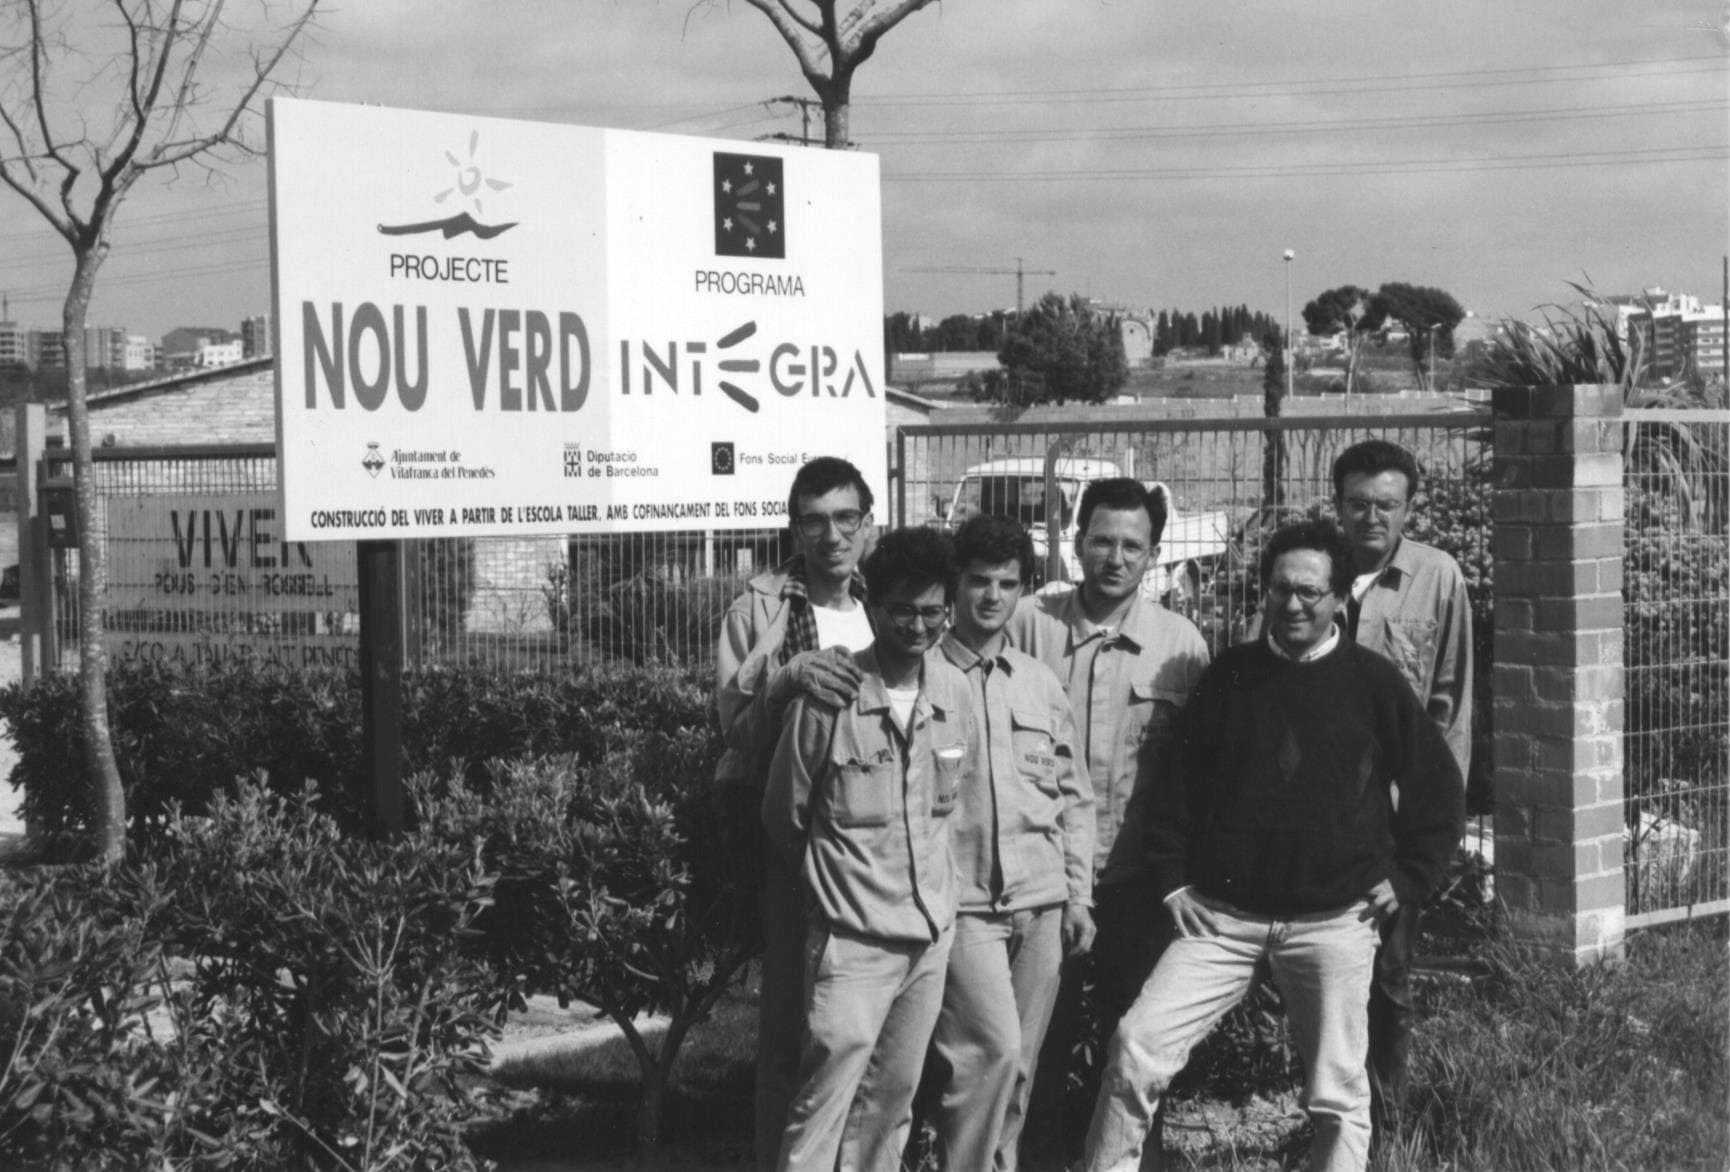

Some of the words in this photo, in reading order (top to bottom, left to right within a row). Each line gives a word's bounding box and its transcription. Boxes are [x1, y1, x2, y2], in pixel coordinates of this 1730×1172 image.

[390, 253, 509, 283] PROJECTE
[695, 269, 806, 297] PROGRAMA
[302, 300, 429, 412] NOU
[457, 306, 591, 413] VERD
[620, 320, 876, 413] INTEGRA
[391, 448, 447, 464] Ajuntament
[449, 451, 462, 462] de
[739, 452, 764, 465] Fons
[767, 452, 798, 465] Social
[441, 466, 455, 479] del
[587, 465, 602, 477] de
[606, 464, 659, 478] Barcelona
[311, 506, 386, 528] CONSTRUCCIÓ
[391, 508, 409, 527] DEL
[414, 508, 445, 526] VIVER
[449, 508, 458, 524] A
[462, 507, 496, 524] PARTIR
[500, 506, 513, 523] DE
[518, 504, 563, 523] L'ESCOLA
[606, 504, 629, 520] AMB
[715, 501, 730, 518] DEL
[734, 501, 758, 517] FONS
[762, 500, 789, 516] SOCIA
